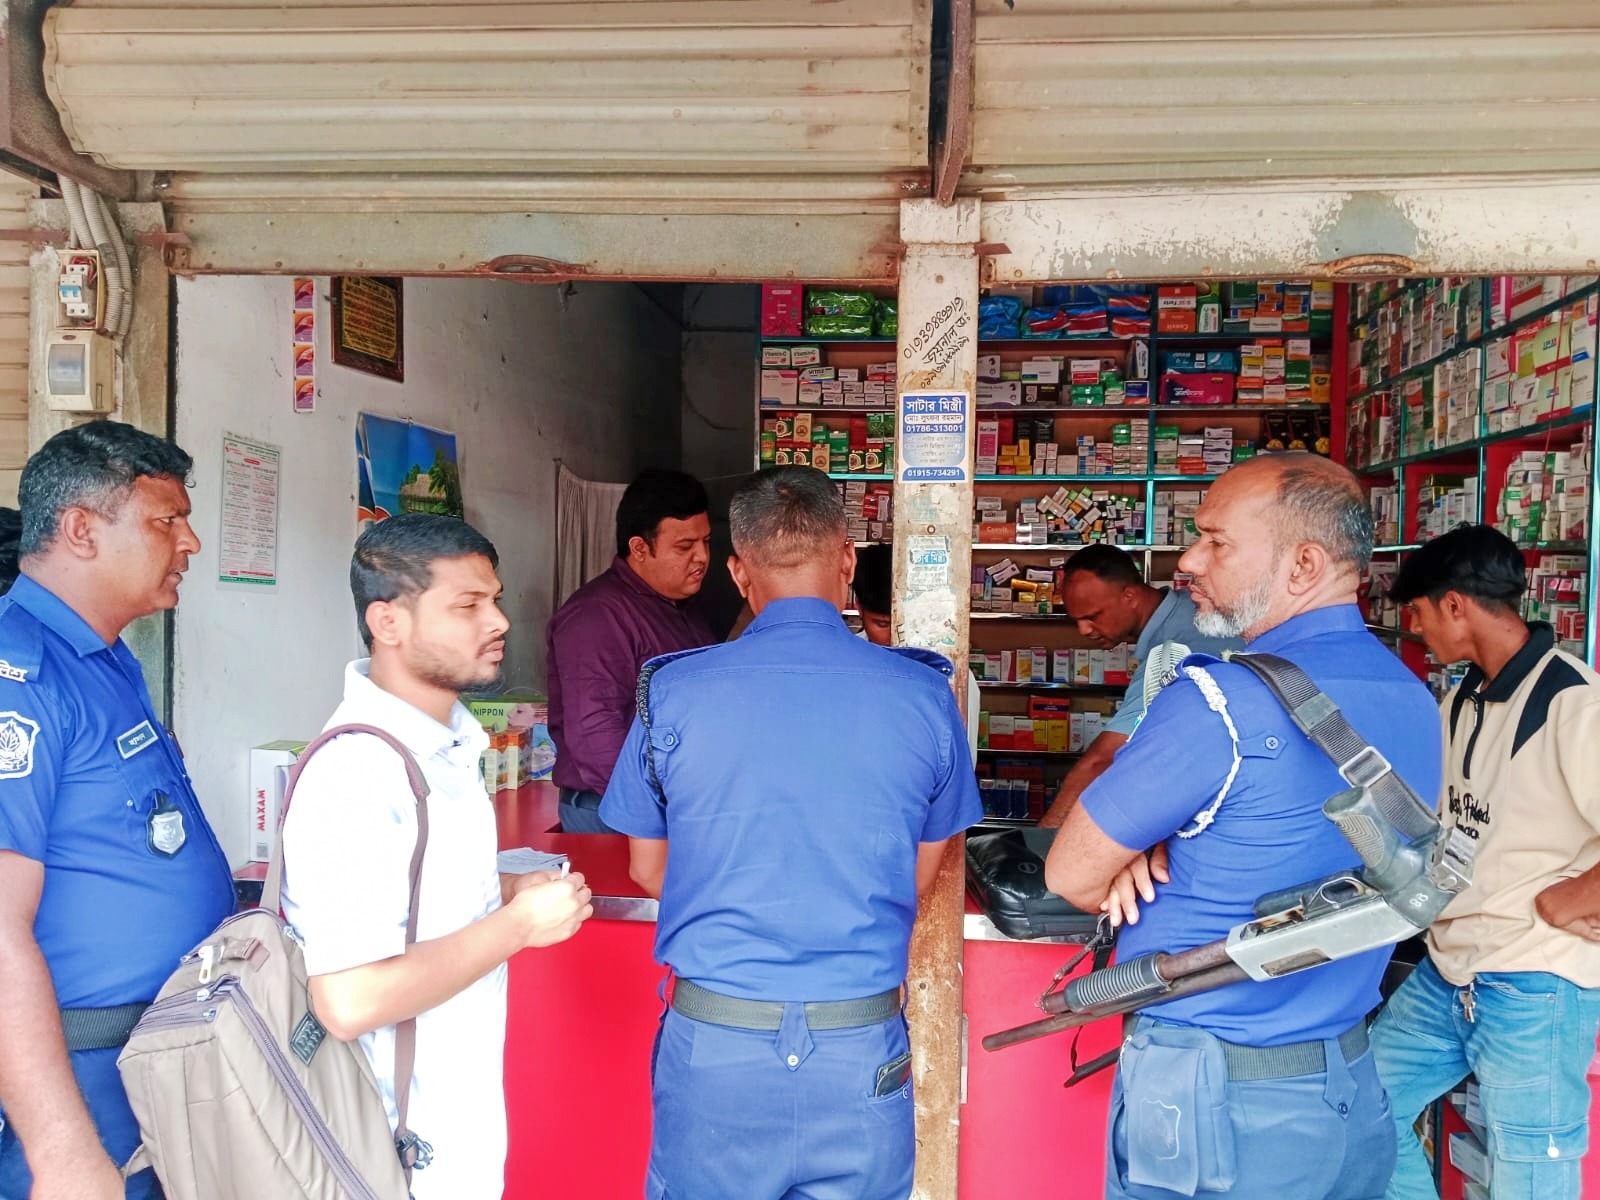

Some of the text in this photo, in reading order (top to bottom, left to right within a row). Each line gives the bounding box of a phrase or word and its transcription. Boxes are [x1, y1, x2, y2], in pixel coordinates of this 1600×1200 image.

[906, 399, 936, 412] সাটার
[473, 708, 504, 716] NIPPON
[256, 789, 267, 831] MAXAM
